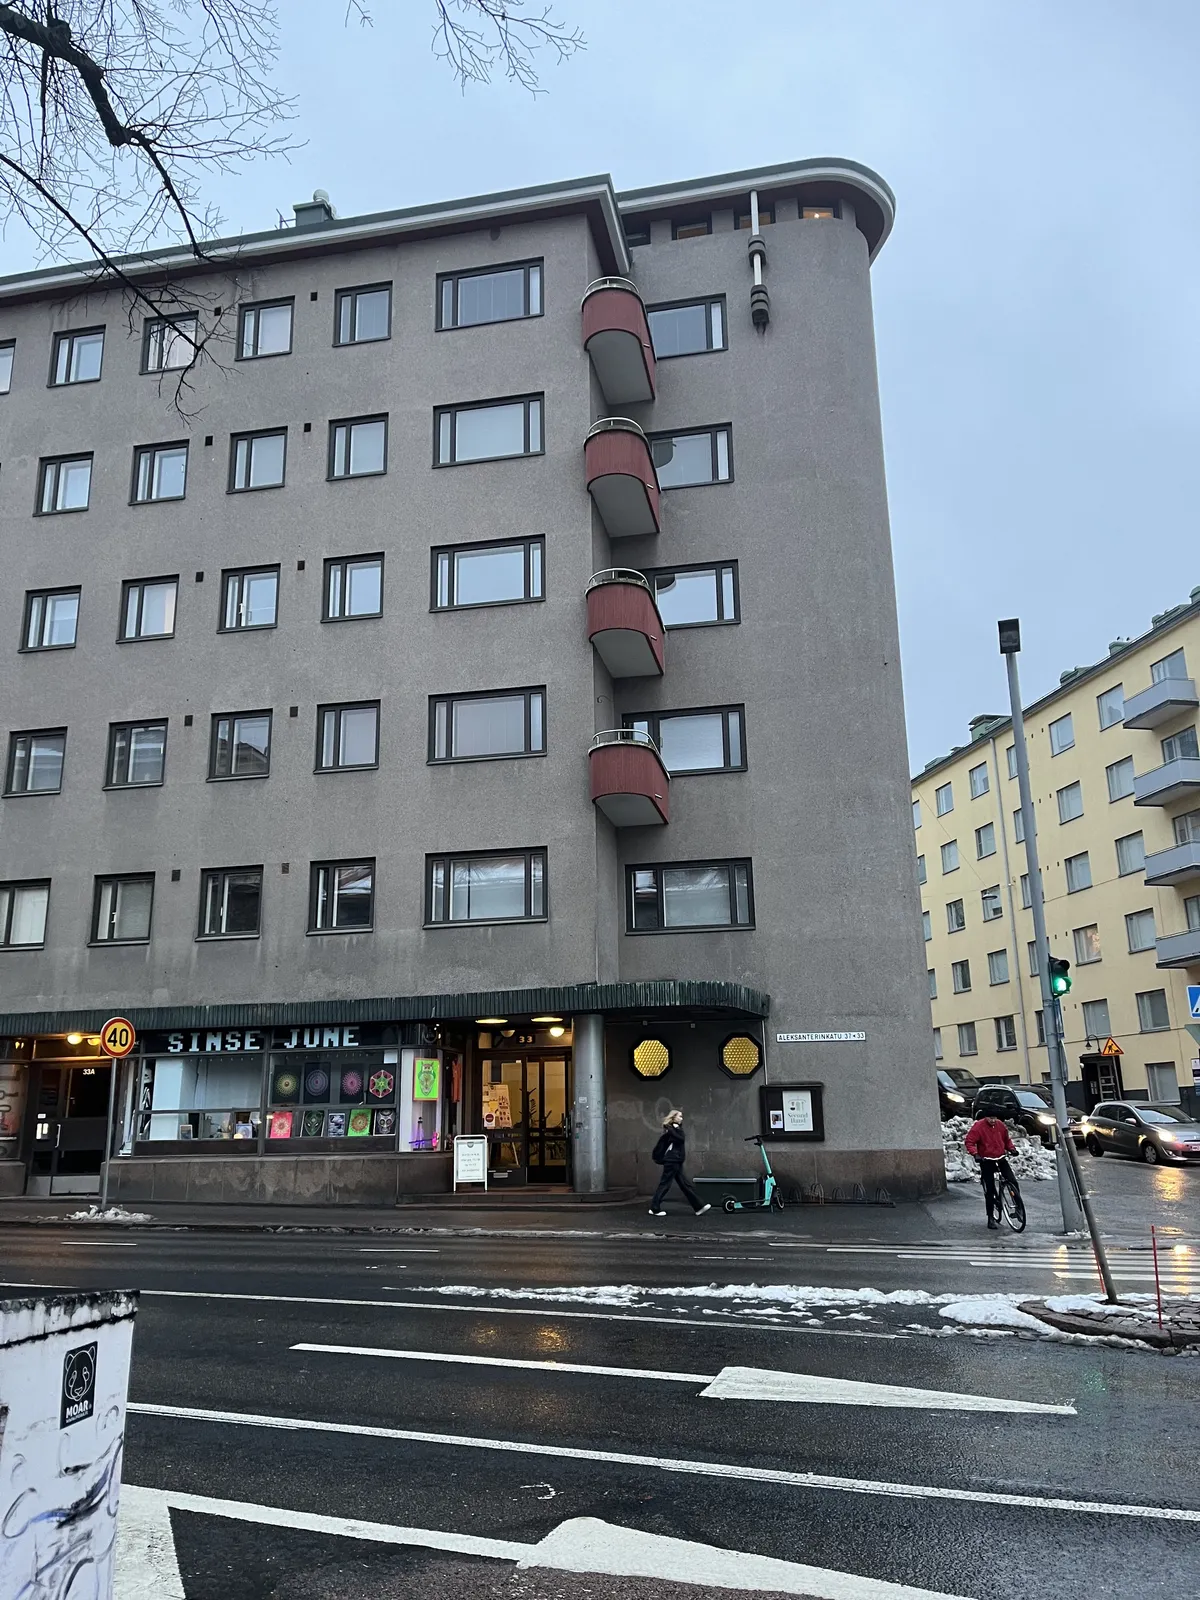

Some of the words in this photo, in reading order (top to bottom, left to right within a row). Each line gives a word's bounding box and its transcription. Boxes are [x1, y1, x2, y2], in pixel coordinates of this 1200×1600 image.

[107, 1027, 129, 1047] 40
[167, 1030, 261, 1053] SINSE
[283, 1026, 360, 1049] JUNE
[518, 1035, 533, 1043] 33
[778, 1033, 842, 1041] ALEKSANTERINKATU
[65, 1399, 89, 1419] MOAR
